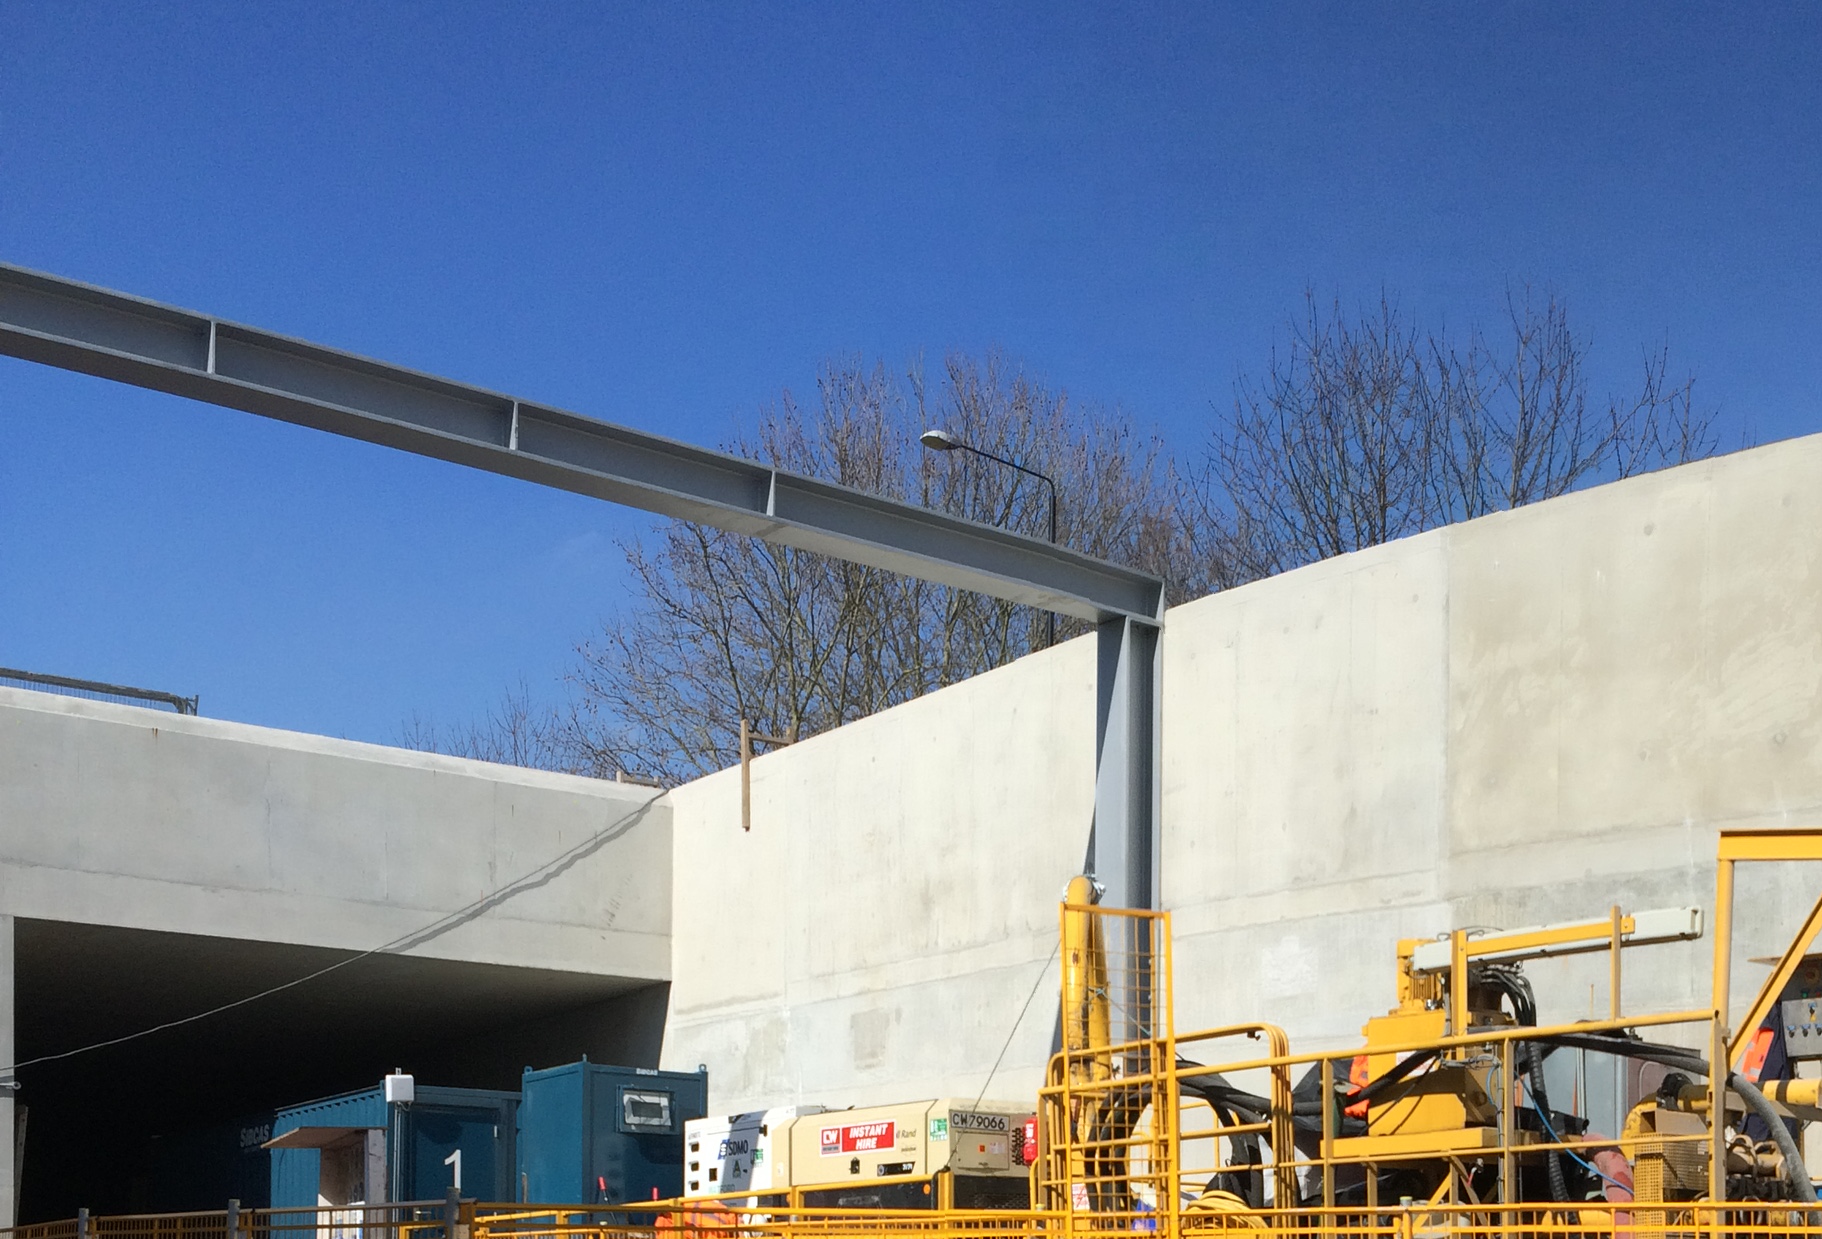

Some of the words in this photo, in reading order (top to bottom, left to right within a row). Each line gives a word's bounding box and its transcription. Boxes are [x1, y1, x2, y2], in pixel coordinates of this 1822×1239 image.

[849, 1123, 888, 1139] INSTANT
[952, 1113, 1005, 1131] CW79066
[728, 1139, 749, 1157] SDMO
[855, 1137, 878, 1151] HIRE
[444, 1149, 462, 1190] 1
